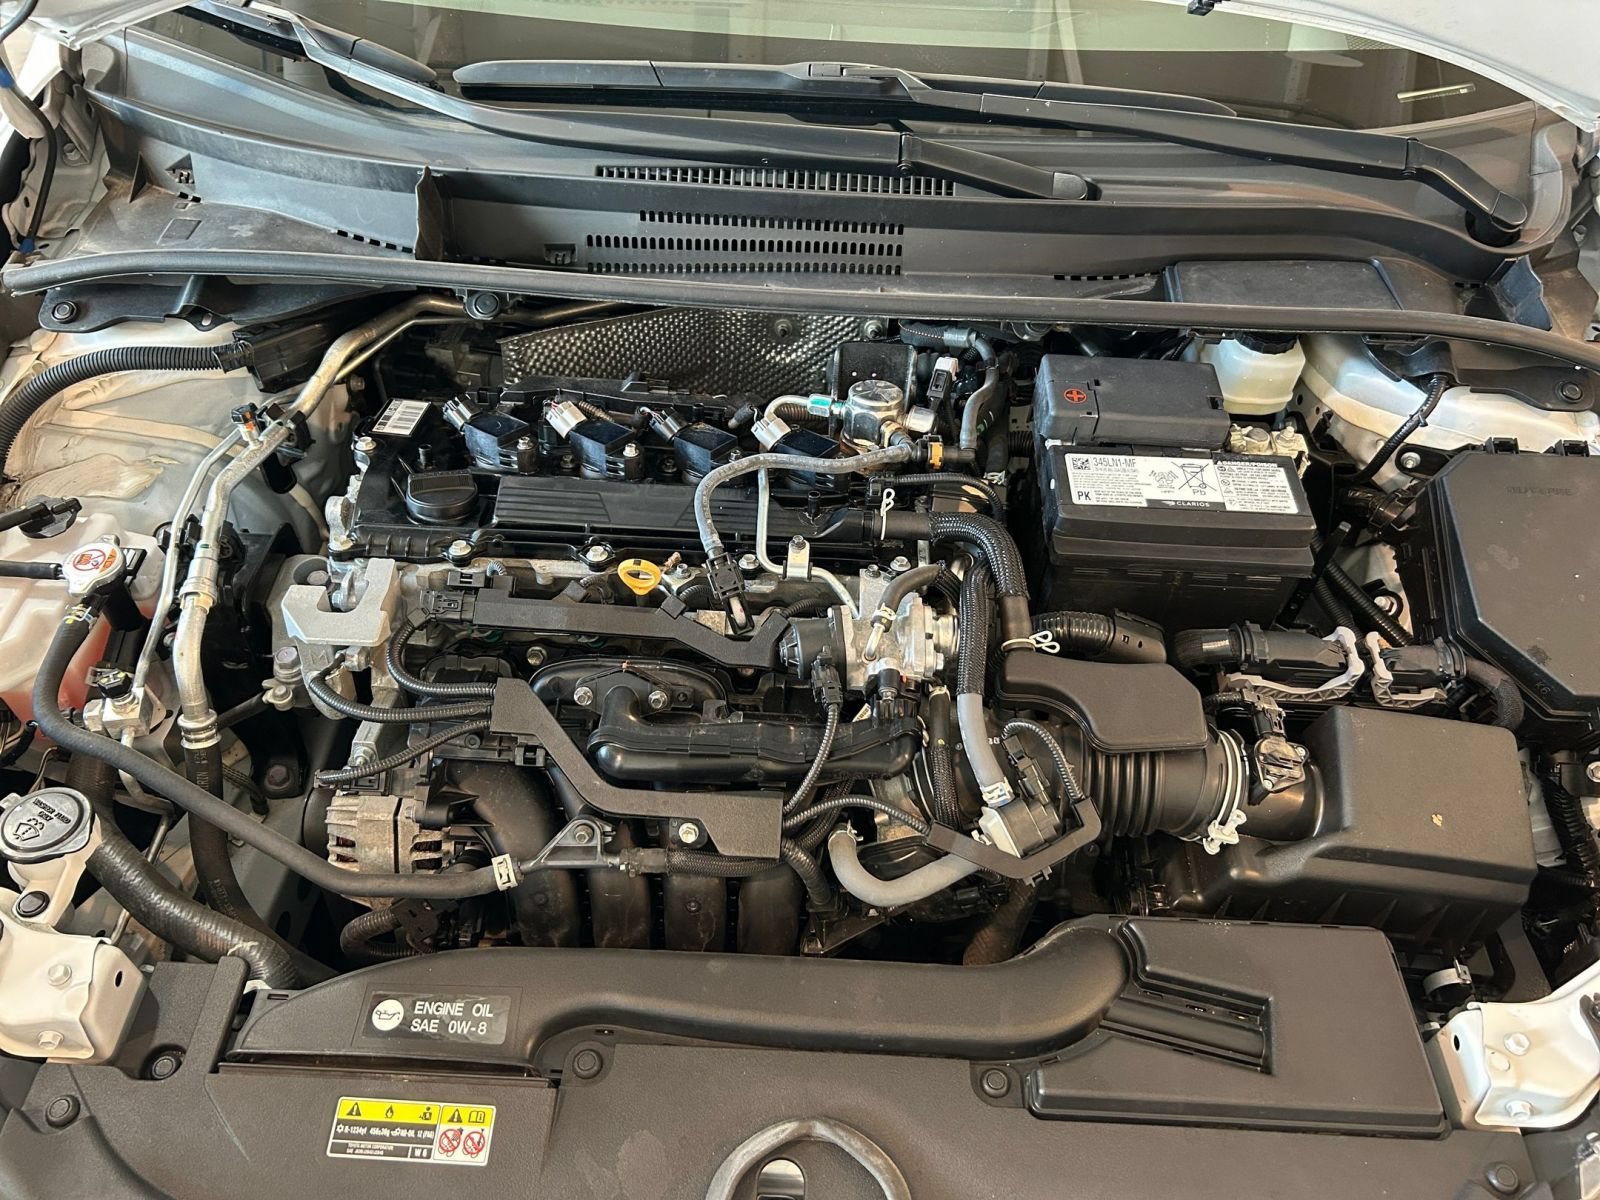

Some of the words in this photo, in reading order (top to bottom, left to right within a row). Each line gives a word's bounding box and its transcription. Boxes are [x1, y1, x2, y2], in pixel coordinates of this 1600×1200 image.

[1093, 457, 1136, 468] 345LN1-MF
[1077, 490, 1091, 501] PK
[1192, 488, 1206, 496] Pb
[414, 1001, 464, 1016] ENGINE
[471, 1003, 494, 1018] OIL
[410, 1018, 440, 1033] SAE
[448, 1020, 488, 1035] 0W-8
